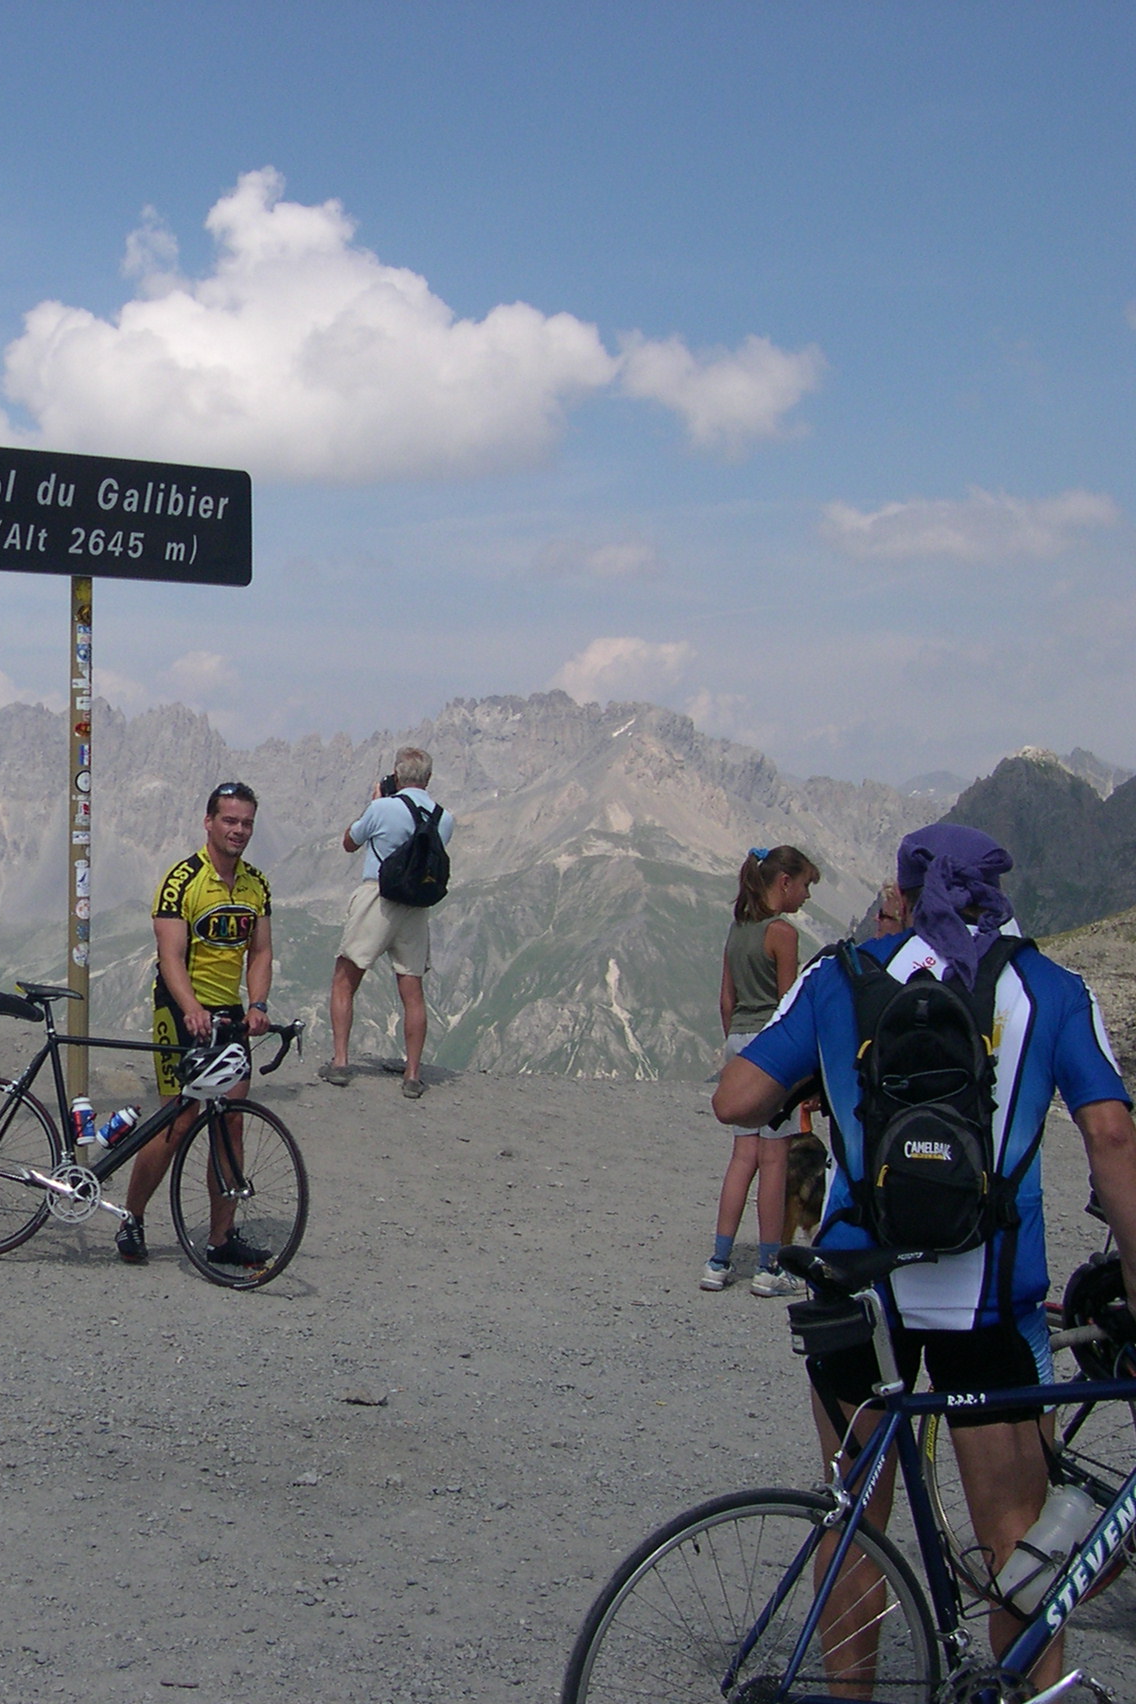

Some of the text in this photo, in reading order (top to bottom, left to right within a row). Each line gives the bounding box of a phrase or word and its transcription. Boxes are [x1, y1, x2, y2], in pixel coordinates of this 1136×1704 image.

[36, 473, 75, 507] du
[96, 477, 229, 520] Galibier
[68, 526, 145, 558] 2645
[164, 534, 198, 565] m)
[162, 862, 195, 912] COAST
[1046, 1484, 1136, 1636] STEVEN
